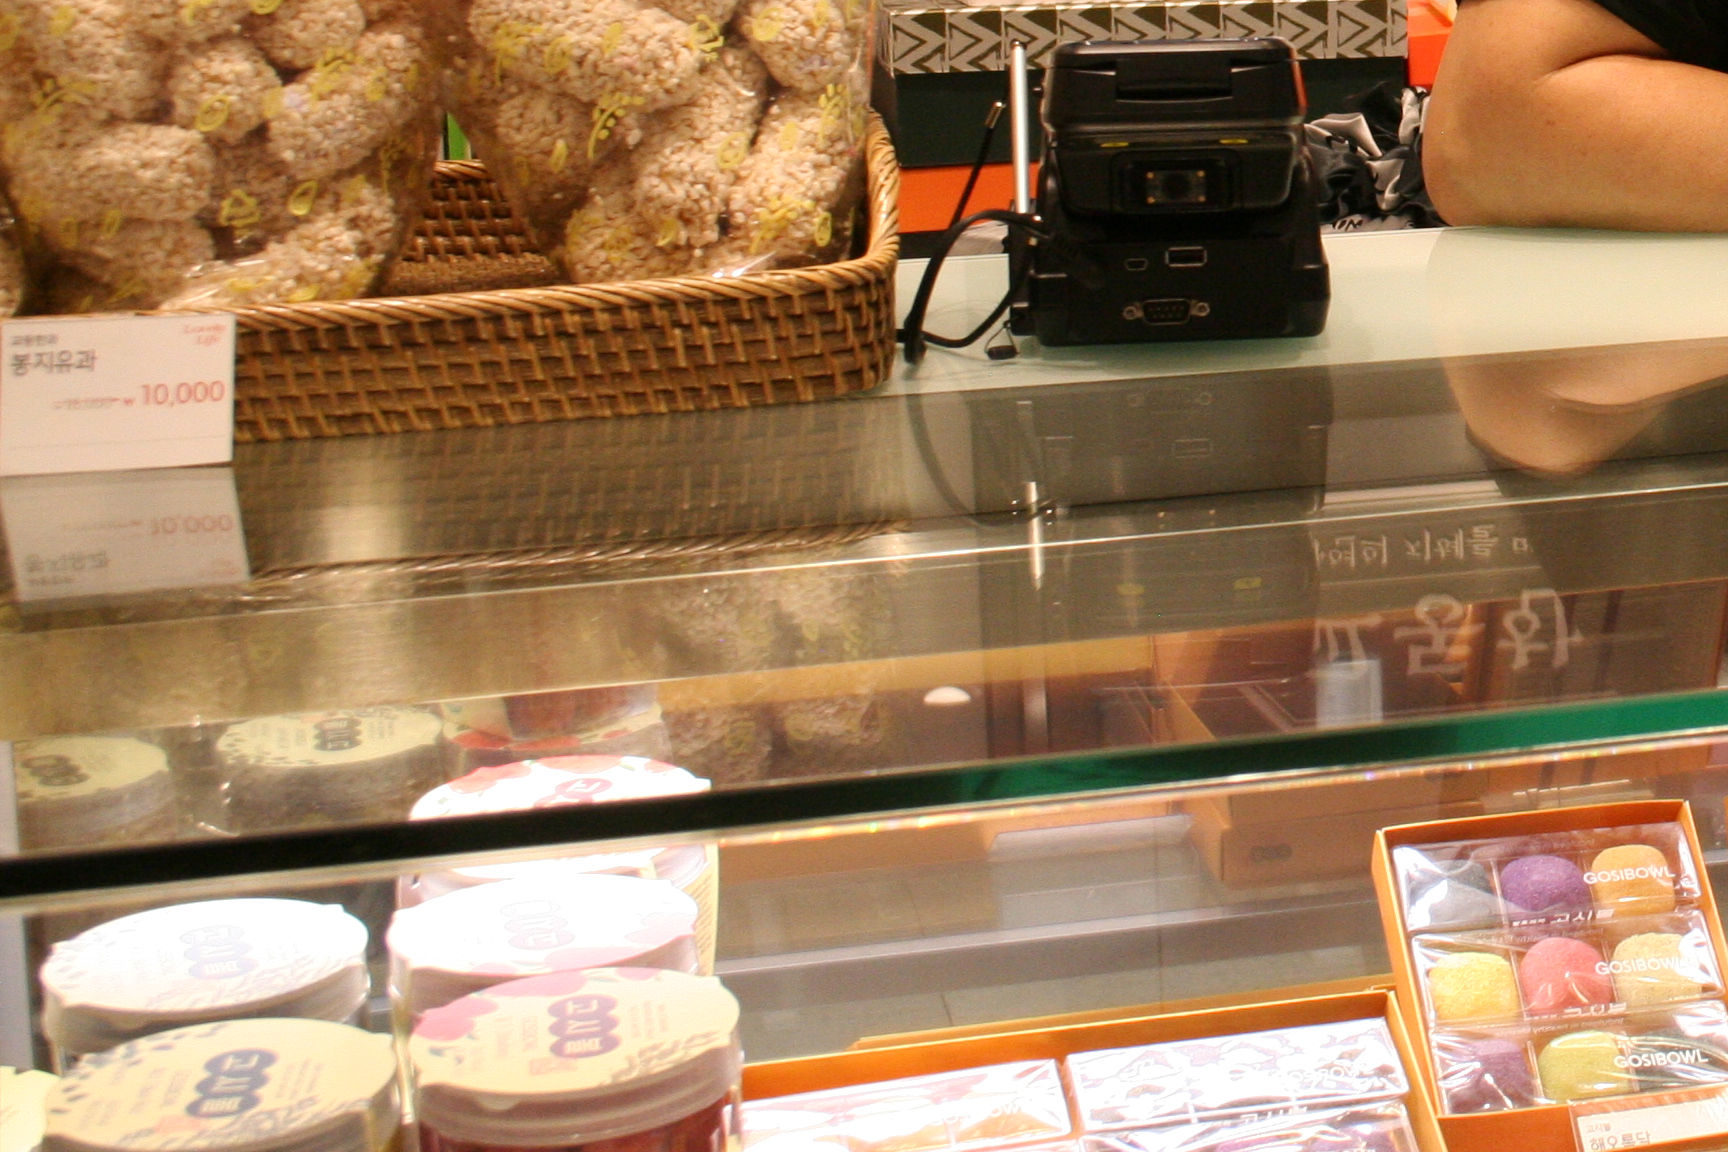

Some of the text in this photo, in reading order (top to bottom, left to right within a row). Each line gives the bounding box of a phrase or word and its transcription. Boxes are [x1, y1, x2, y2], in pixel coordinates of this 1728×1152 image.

[10, 349, 97, 377] 봉지유과
[141, 380, 226, 408] 10,000
[1583, 865, 1677, 886] GOSIBOWL
[1613, 1048, 1709, 1069] GOSIBOWL
